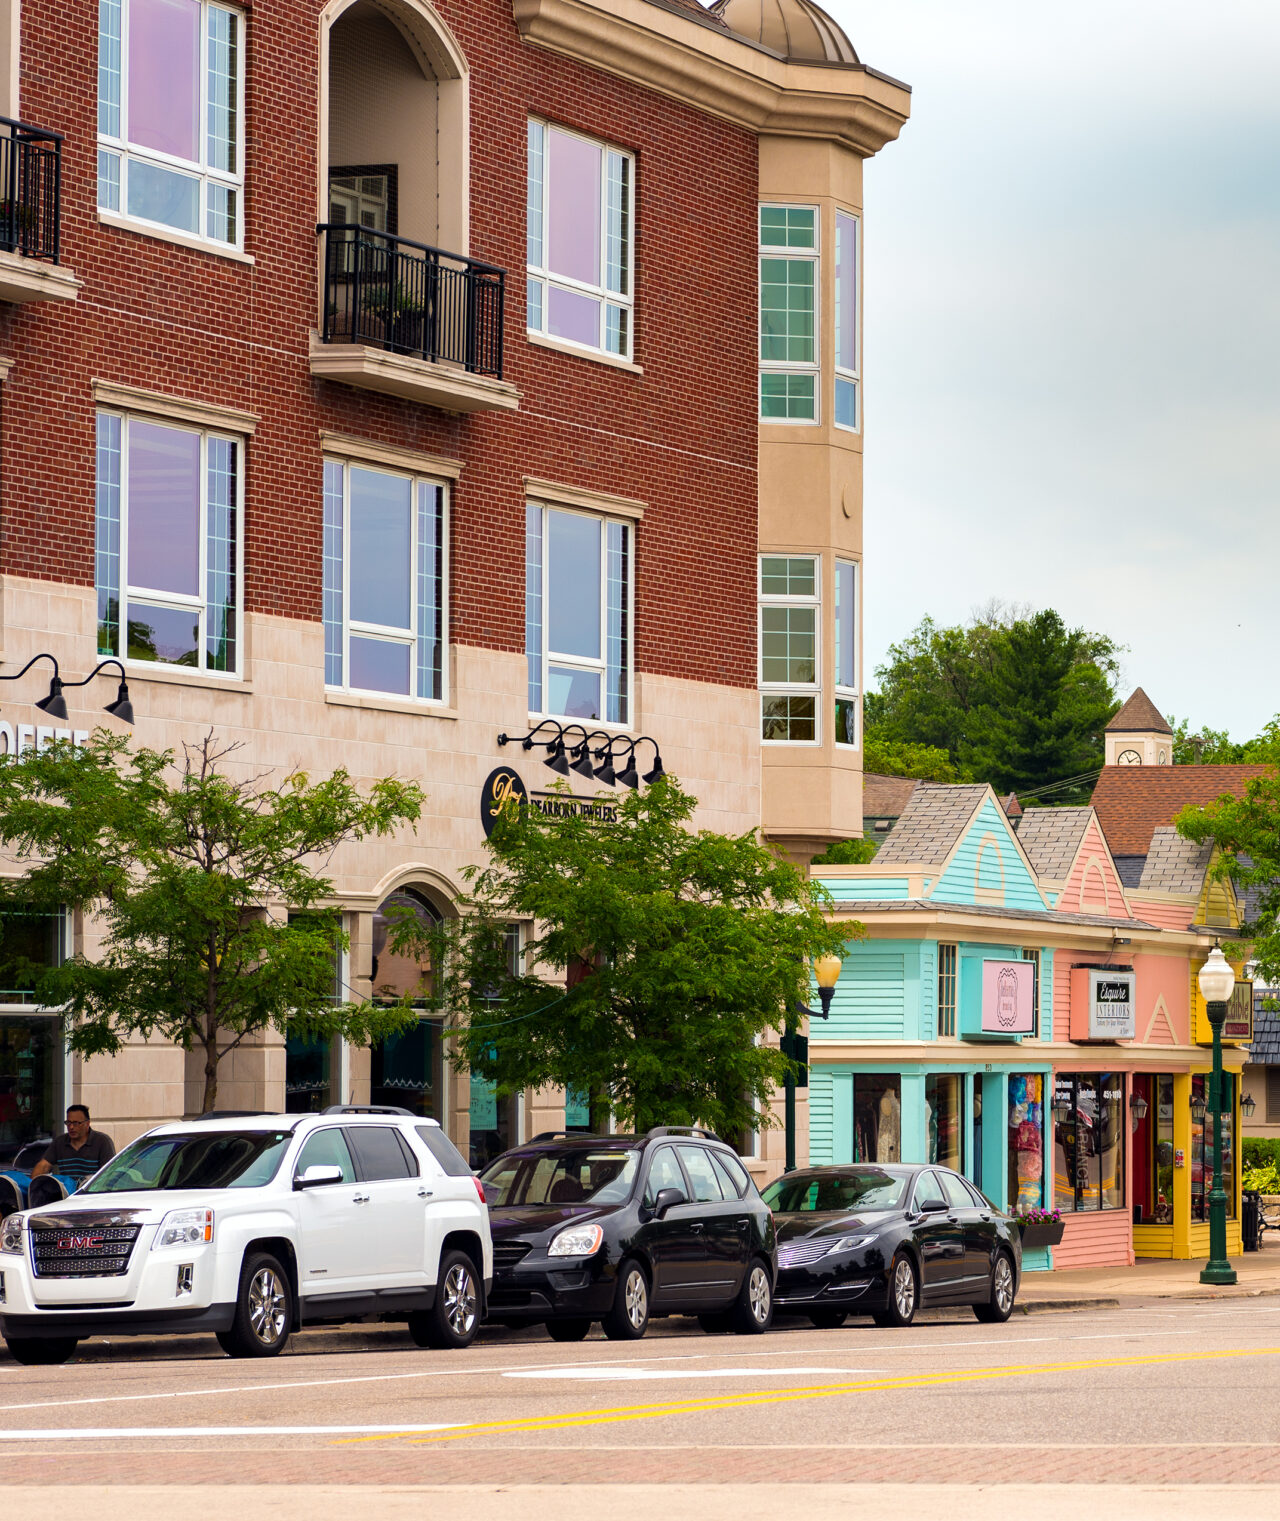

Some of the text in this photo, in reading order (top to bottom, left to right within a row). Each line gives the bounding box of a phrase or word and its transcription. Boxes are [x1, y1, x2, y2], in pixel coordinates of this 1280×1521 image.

[1100, 982, 1127, 1003] Esquire
[1096, 1004, 1130, 1017] INTERIORS
[57, 1236, 104, 1249] GMC
